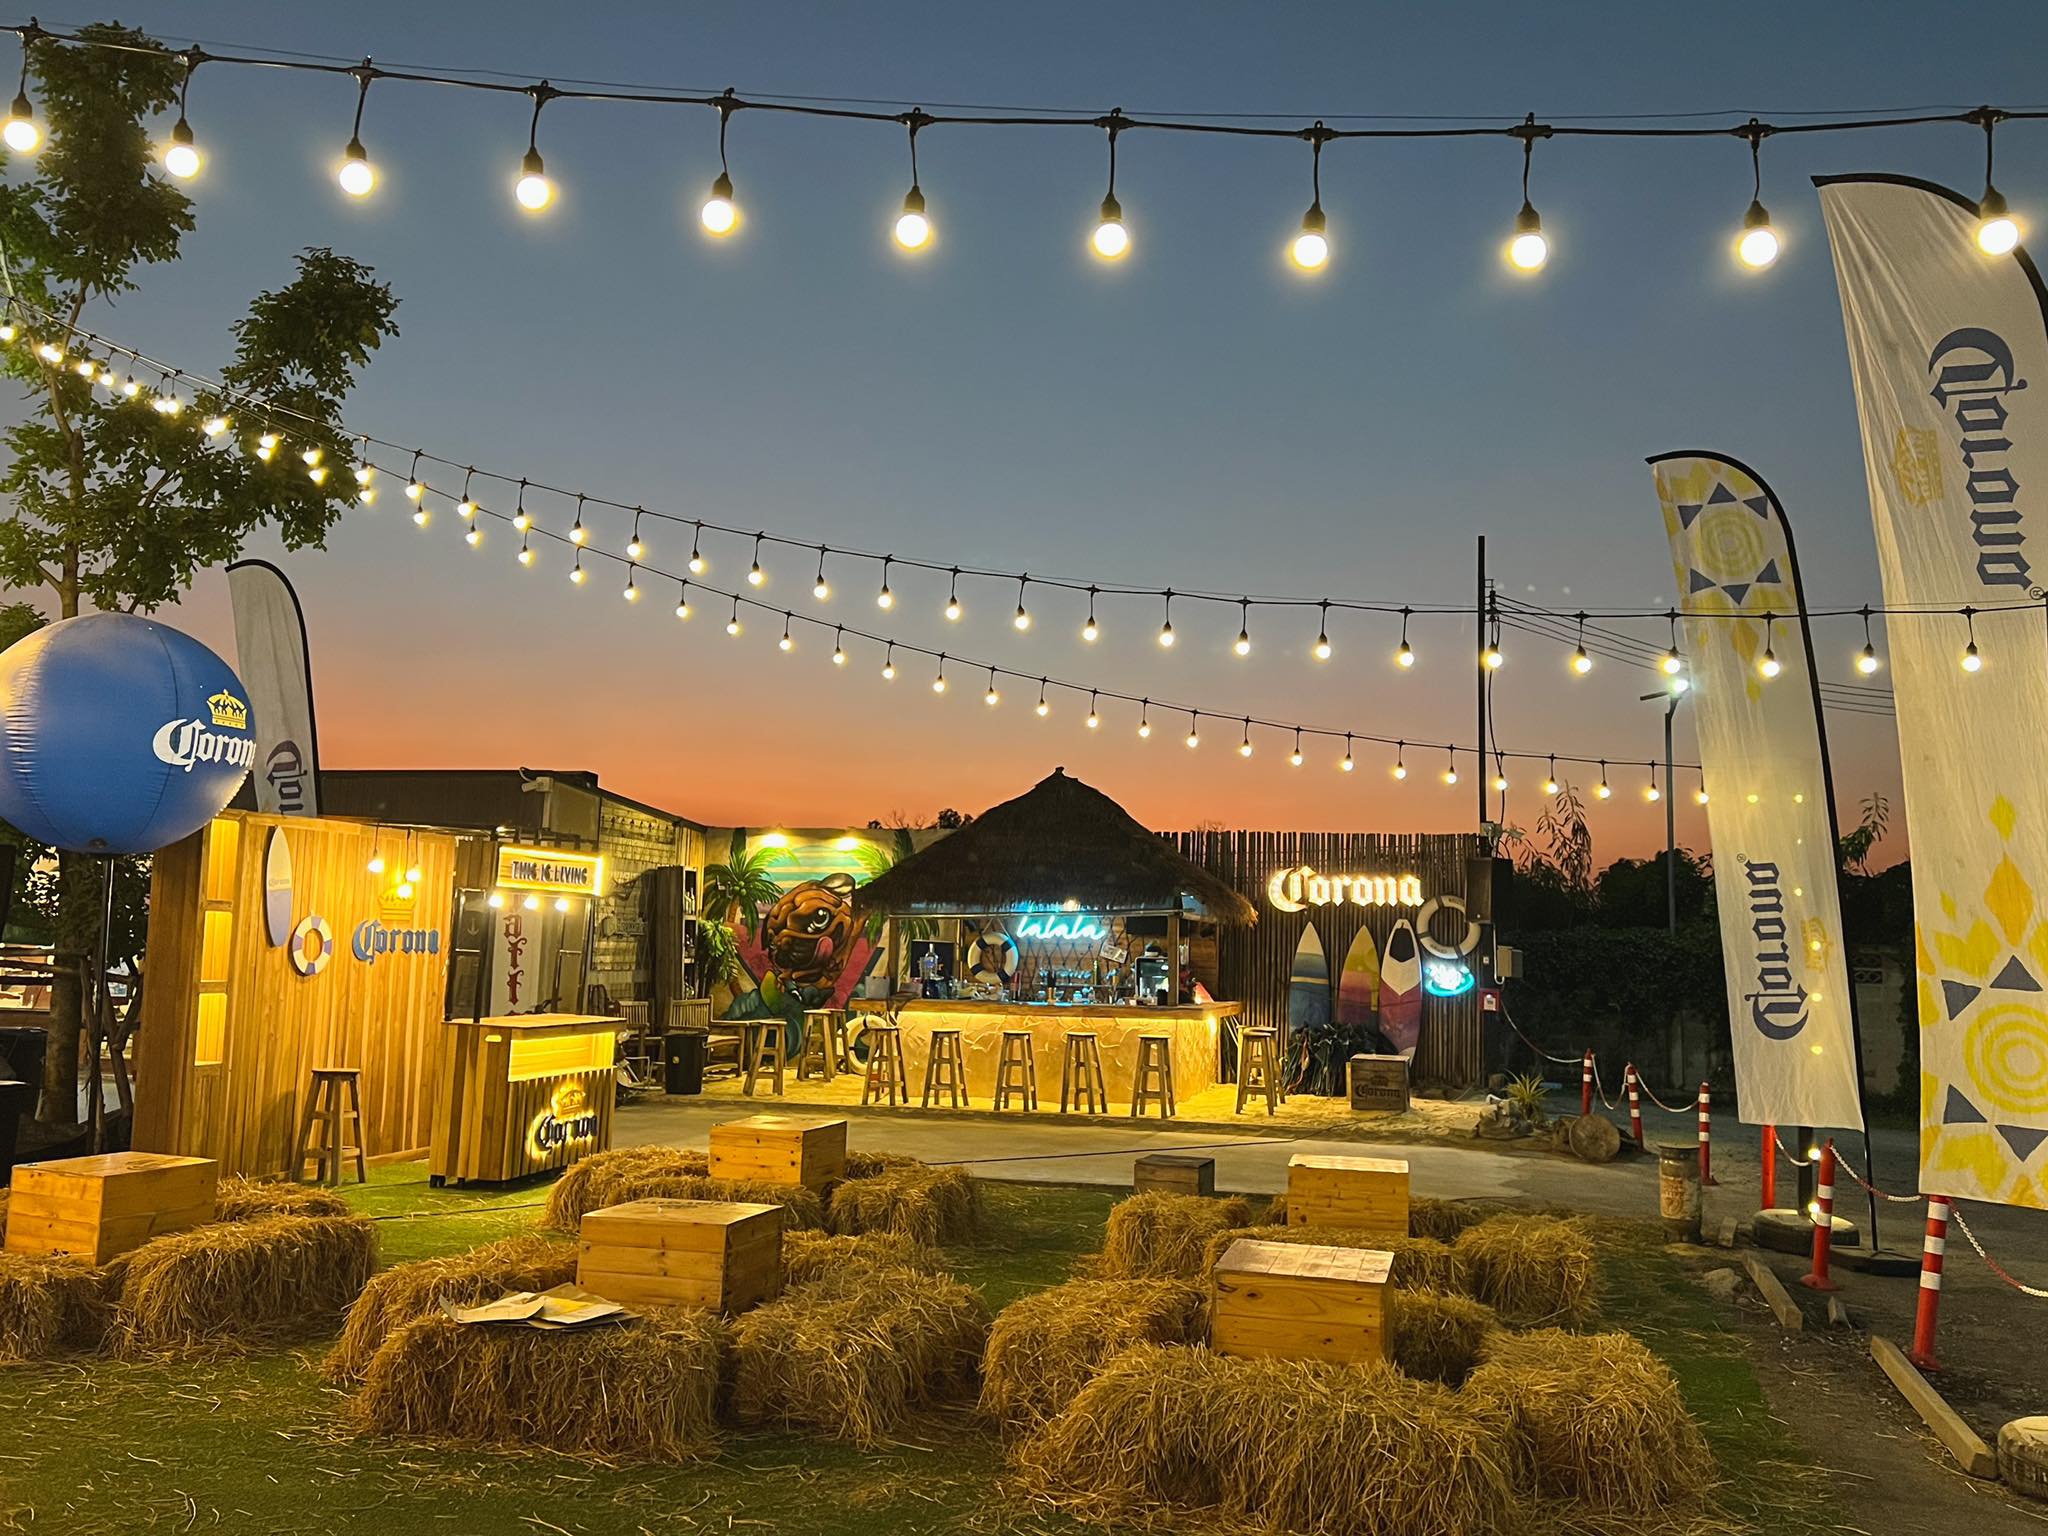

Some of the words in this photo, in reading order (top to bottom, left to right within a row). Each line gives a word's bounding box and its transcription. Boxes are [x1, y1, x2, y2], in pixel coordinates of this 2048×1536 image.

[555, 864, 588, 885] LIVING
[1268, 865, 1425, 914] Corona
[353, 920, 439, 965] Corona
[534, 1114, 597, 1154] Corona
